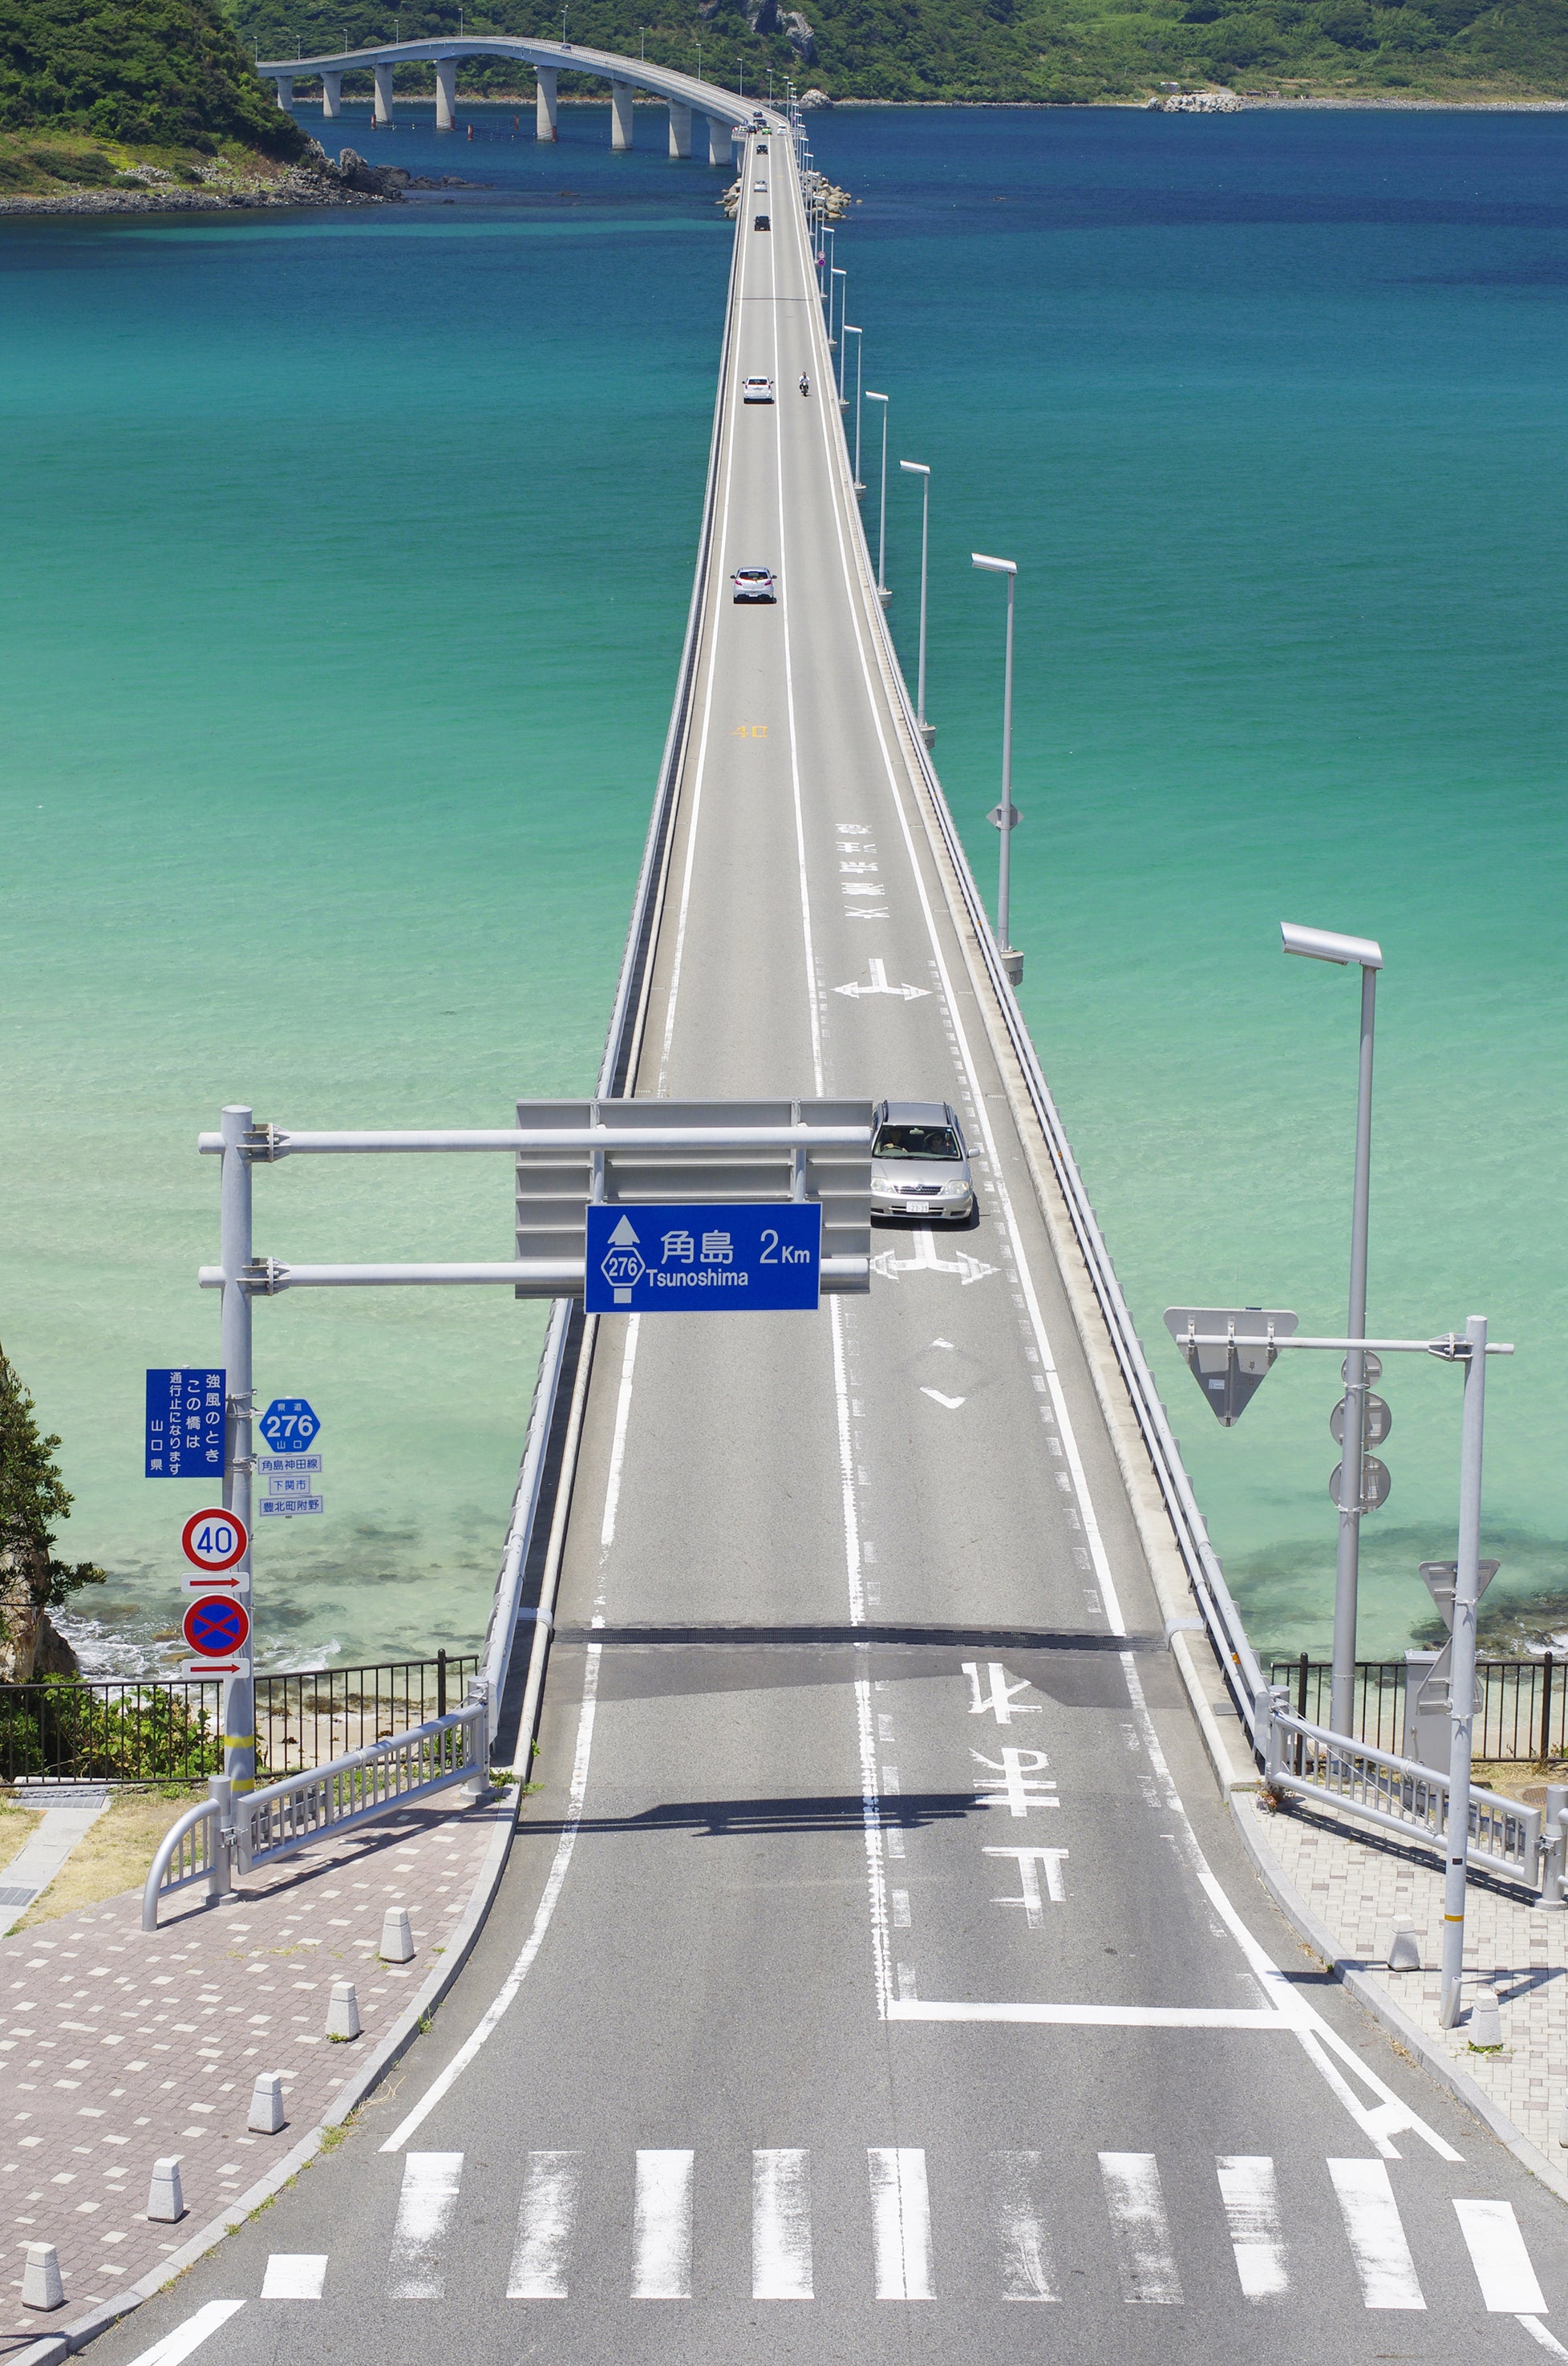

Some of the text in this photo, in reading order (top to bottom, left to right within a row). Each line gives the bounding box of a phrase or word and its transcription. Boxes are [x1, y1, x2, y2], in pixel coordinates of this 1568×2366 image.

[661, 1230, 734, 1265] 角島
[609, 1257, 638, 1277] 276
[646, 1268, 748, 1287] Tsunoshima
[168, 1371, 183, 1475] 通行止になります
[185, 1379, 201, 1448] この橋は
[205, 1374, 221, 1463] 強風のとき
[266, 1415, 314, 1437] 276
[150, 1419, 164, 1471] 山口県
[277, 1440, 302, 1449] 山口
[262, 1458, 318, 1471] 角島神田線
[273, 1480, 306, 1491] 下関市
[263, 1499, 319, 1513] 豊北町附野
[197, 1526, 232, 1554] 40
